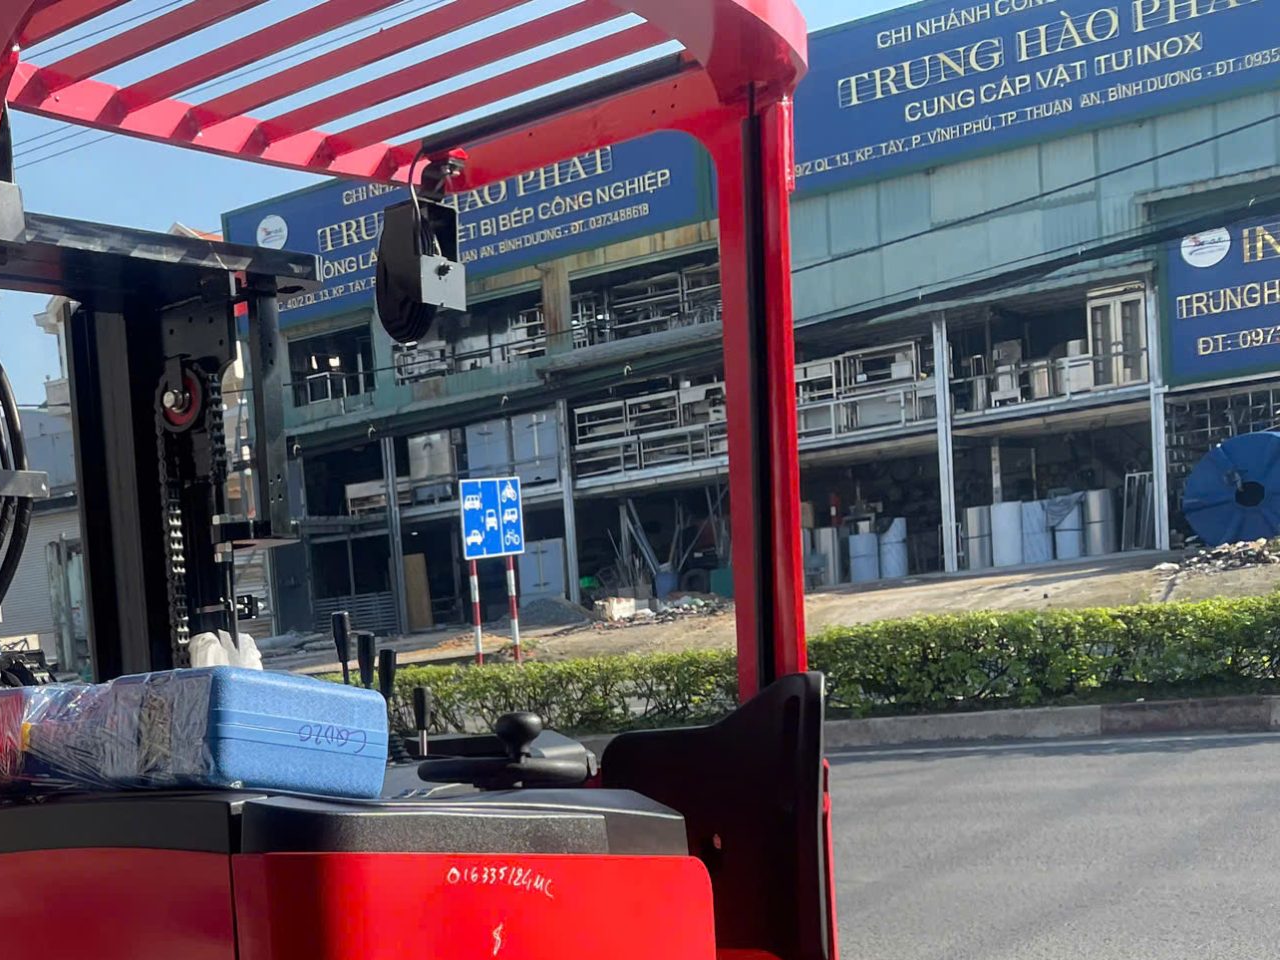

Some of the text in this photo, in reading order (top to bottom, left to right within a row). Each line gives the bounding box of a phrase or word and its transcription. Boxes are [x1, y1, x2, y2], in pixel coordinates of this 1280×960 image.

[877, 25, 911, 48] CHI
[916, 8, 991, 38] NHÁNH
[838, 37, 1004, 107] TRUNG
[1017, 10, 1119, 61] HÀO
[905, 89, 975, 122] CUNG
[1137, 32, 1202, 65] INOX
[815, 157, 831, 171] QL
[342, 186, 367, 205] CHI
[538, 191, 593, 219] CÔNG
[318, 211, 384, 252] TRU
